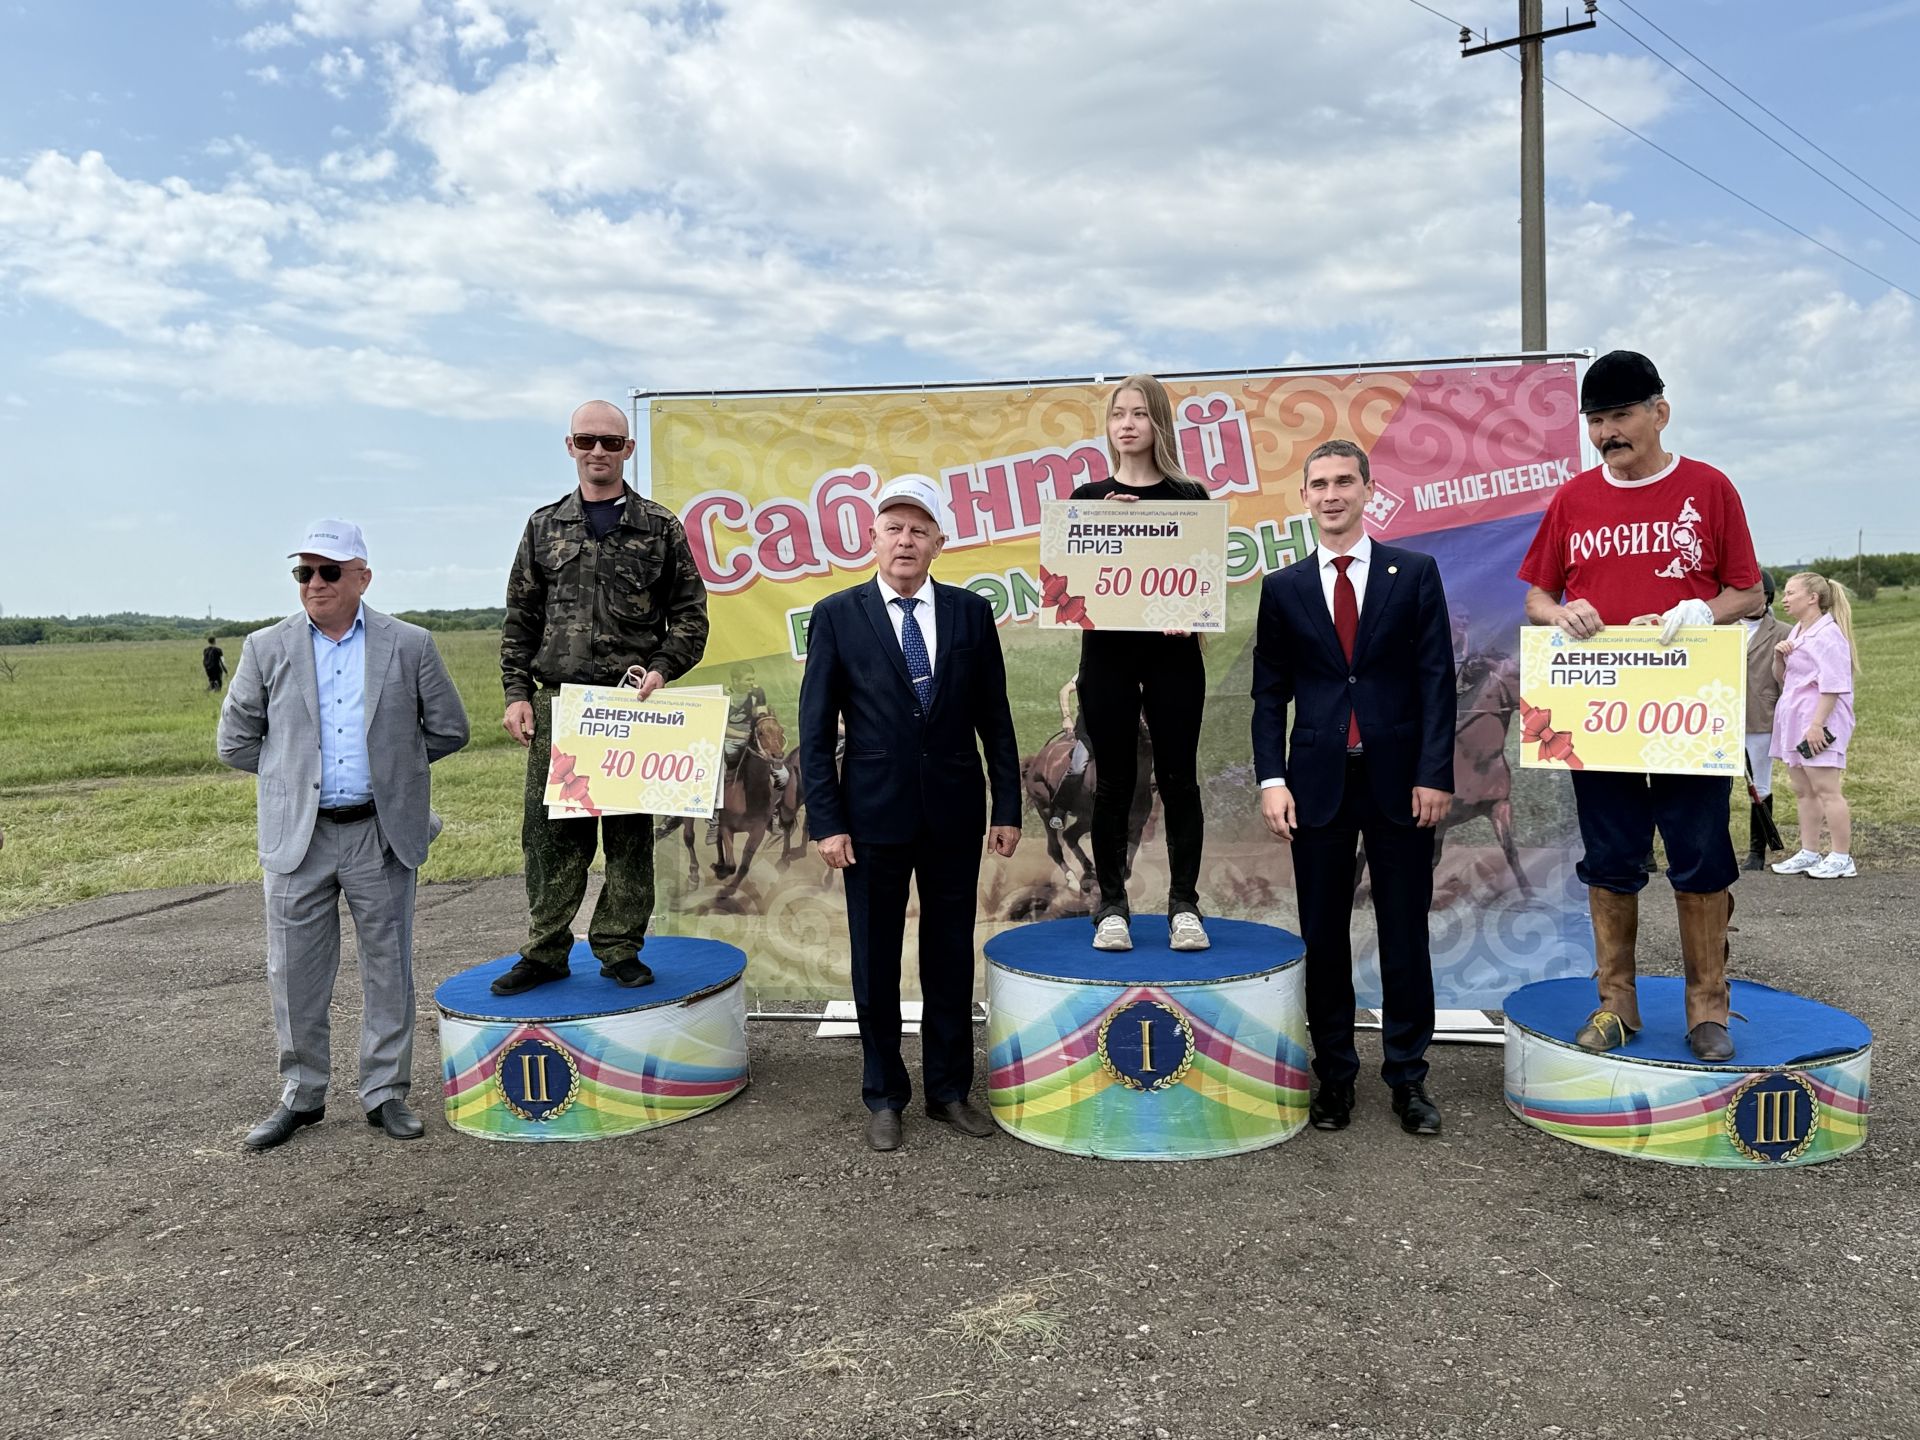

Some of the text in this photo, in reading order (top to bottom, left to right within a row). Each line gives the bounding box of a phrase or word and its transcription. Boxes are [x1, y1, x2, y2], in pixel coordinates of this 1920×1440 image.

[684, 399, 1250, 585] Сабнтй
[1412, 457, 1571, 513] МЕНДЕЛЕЕВСК
[1068, 521, 1179, 538] ДЕНЕЖНЫЙ
[1569, 521, 1671, 564] РОССИЯ
[1067, 539, 1123, 554] ПРИЗ
[1095, 566, 1132, 597] 50
[1551, 649, 1687, 667] ДЕНЕЖНЫЙ
[1550, 670, 1617, 686] ПРИЗ
[579, 721, 631, 738] ПРИЗ
[581, 707, 685, 726] ДЕНЕЖНЫЙ
[1584, 700, 1629, 734] 30
[600, 749, 636, 779] 40
[1136, 1020, 1157, 1072] I
[518, 1054, 553, 1103] II
[1752, 1089, 1801, 1144] III
